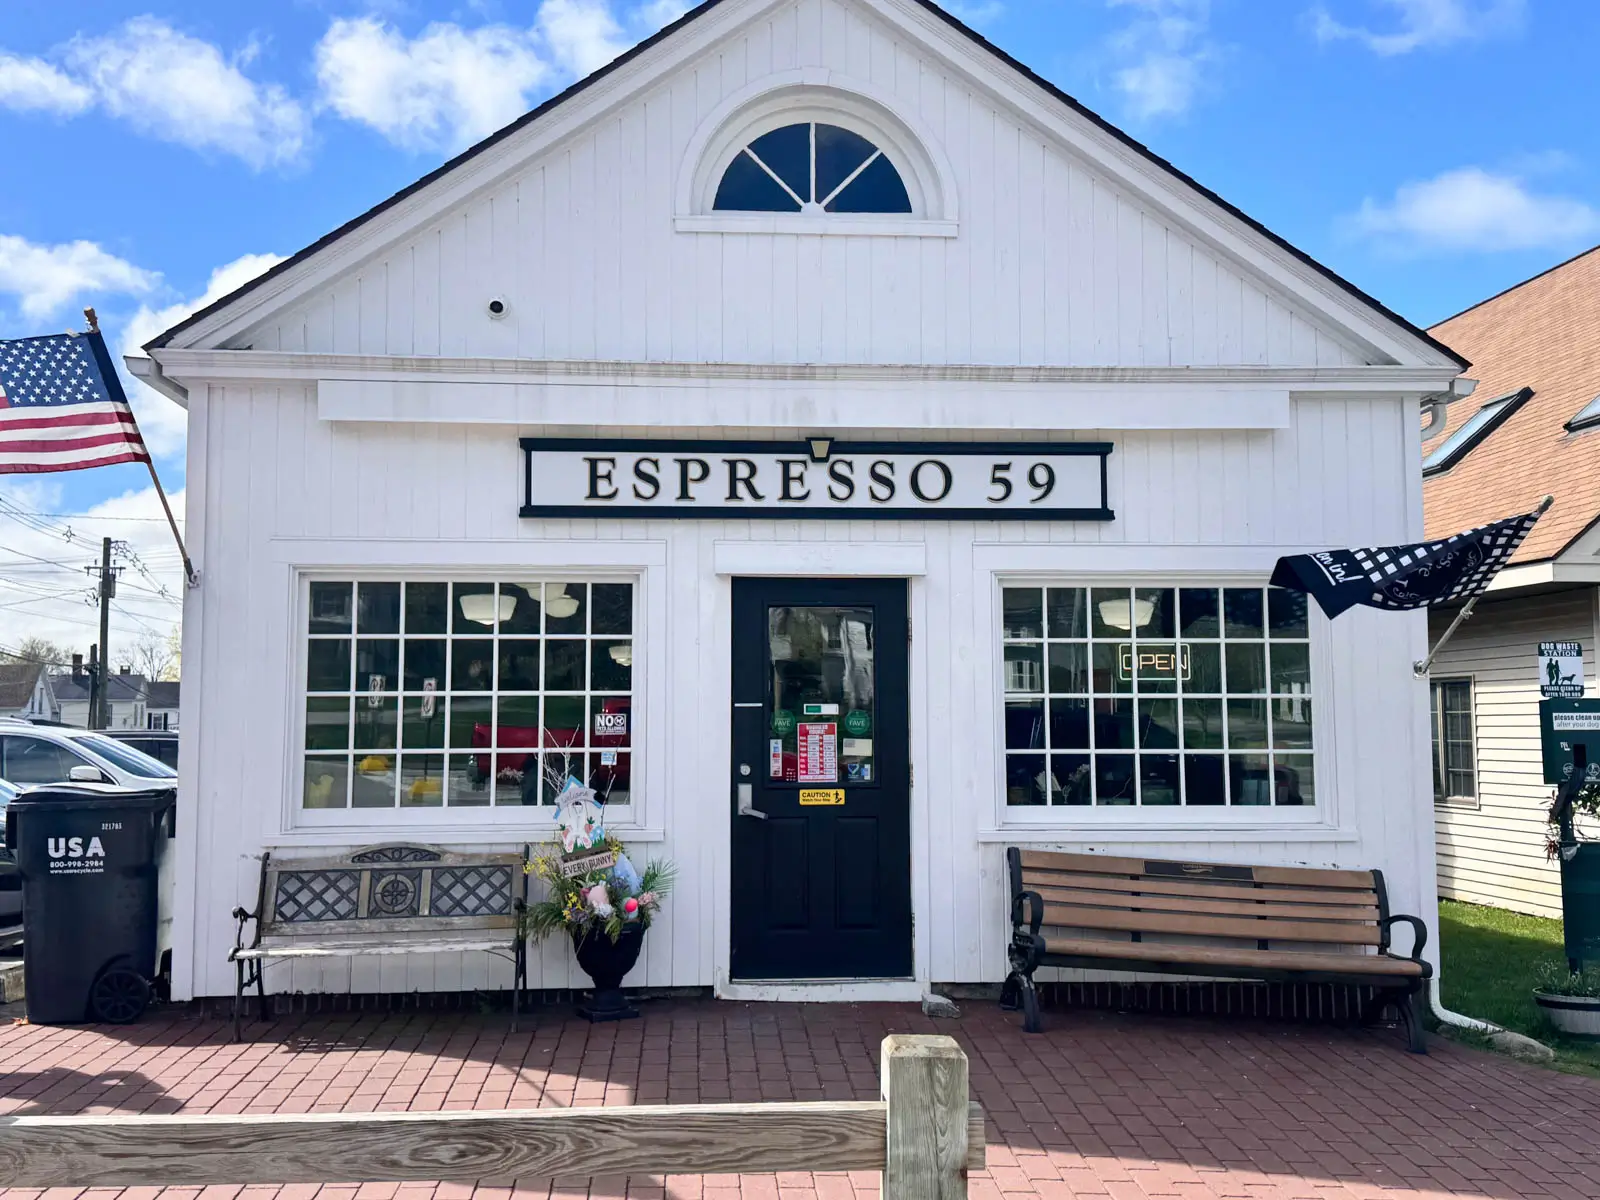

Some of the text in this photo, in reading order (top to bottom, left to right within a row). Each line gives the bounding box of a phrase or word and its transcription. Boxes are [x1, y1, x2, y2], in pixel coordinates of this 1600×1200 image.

[582, 457, 1056, 504] ESPRESSO 59
[1541, 642, 1579, 650] DOG WASTE
[1122, 653, 1187, 671] OPEN
[597, 715, 614, 727] NO
[1554, 713, 1575, 721] please
[1575, 713, 1592, 721] clean
[1586, 721, 1600, 729] dog
[47, 836, 106, 859] USA
